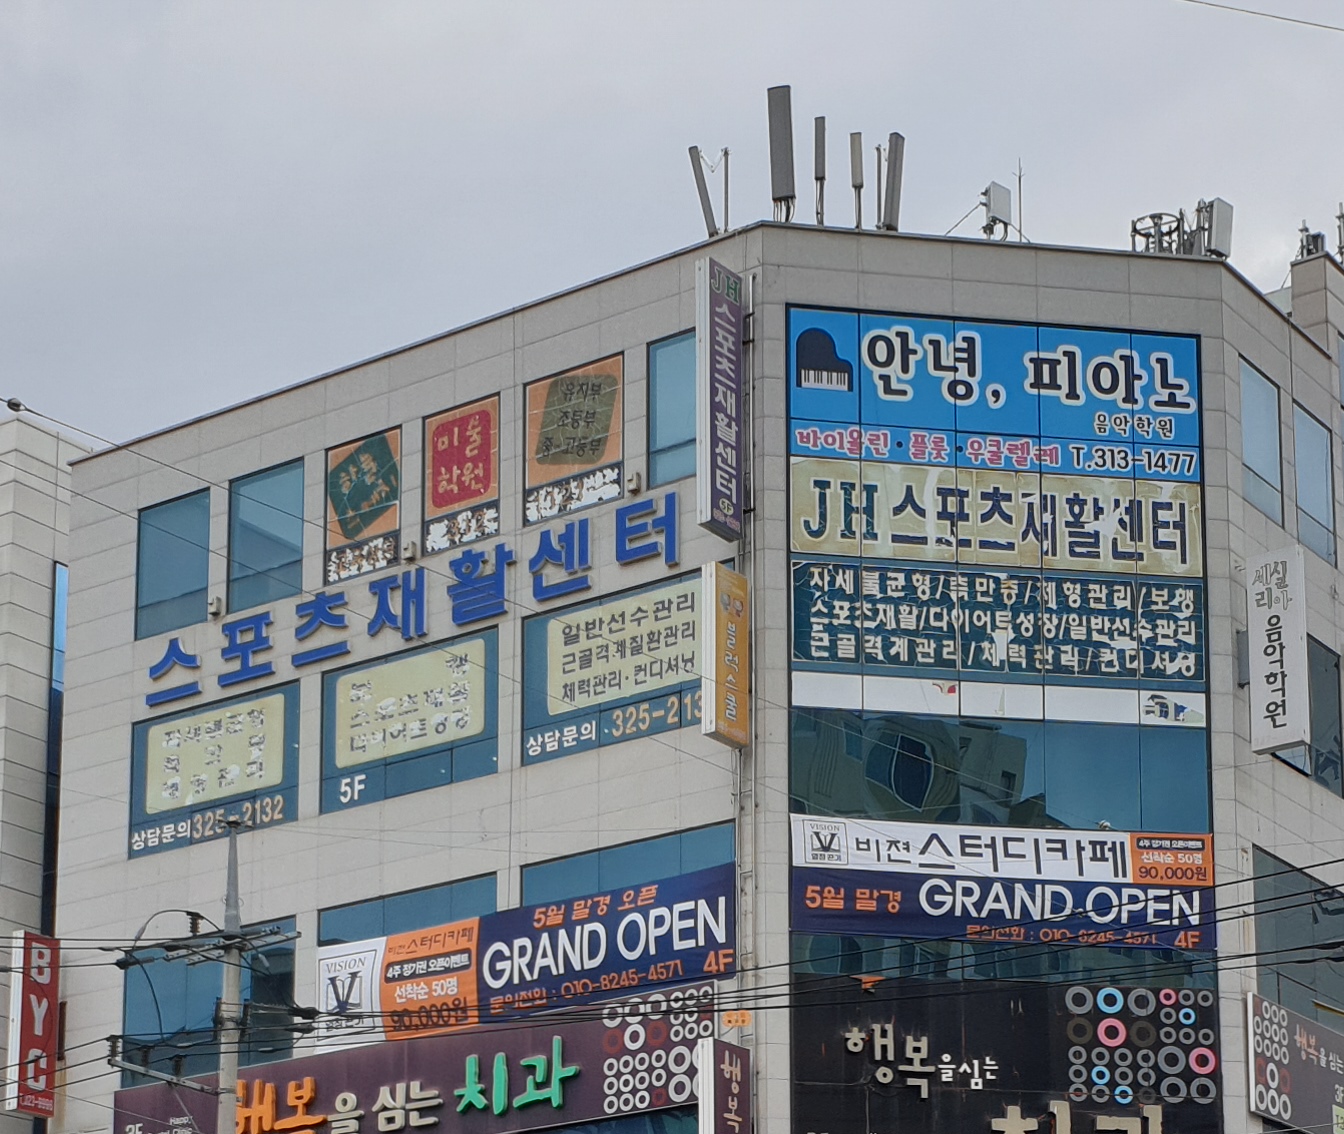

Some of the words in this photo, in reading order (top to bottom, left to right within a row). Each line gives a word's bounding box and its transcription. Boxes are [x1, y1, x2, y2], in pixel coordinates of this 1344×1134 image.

[1027, 345, 1196, 414] 피아노
[715, 302, 739, 504] 스포츠재활센터
[1093, 412, 1174, 440] 음악학원
[796, 428, 891, 459] 바이올린
[1070, 445, 1197, 476] T.313-1477
[803, 478, 880, 541] JH
[890, 484, 1188, 565] 스포츠재활센터
[145, 492, 680, 707] 스포츠재활센터
[562, 592, 695, 647] 일반선수관리
[562, 620, 696, 675] 근골격계질환관리
[1263, 614, 1287, 729] 음악학원
[526, 720, 597, 756] 상담문의
[338, 774, 367, 805] 5F
[131, 820, 192, 852] 상담문의
[193, 795, 284, 839] 325-2132
[809, 822, 841, 832] VISION
[1137, 865, 1208, 882] 90,000원
[1177, 852, 1204, 865] 50명
[532, 905, 566, 929] 5월
[570, 892, 611, 921] 말경
[616, 884, 659, 911] 오픈
[804, 885, 845, 910] 5월
[854, 887, 902, 912] 말경
[918, 877, 1080, 921] GRAND
[1085, 886, 1201, 925] OPEN
[482, 921, 607, 990] GRAND
[616, 895, 727, 961] OPEN
[1173, 930, 1201, 948] 4F
[325, 956, 366, 973] VISION
[561, 959, 684, 1001] 010-8245-4571
[702, 947, 735, 975] 4F
[394, 985, 429, 1003] 선착순
[431, 977, 458, 997] 50명
[454, 1034, 580, 1117] 치과
[1335, 1083, 1344, 1103] 3F
